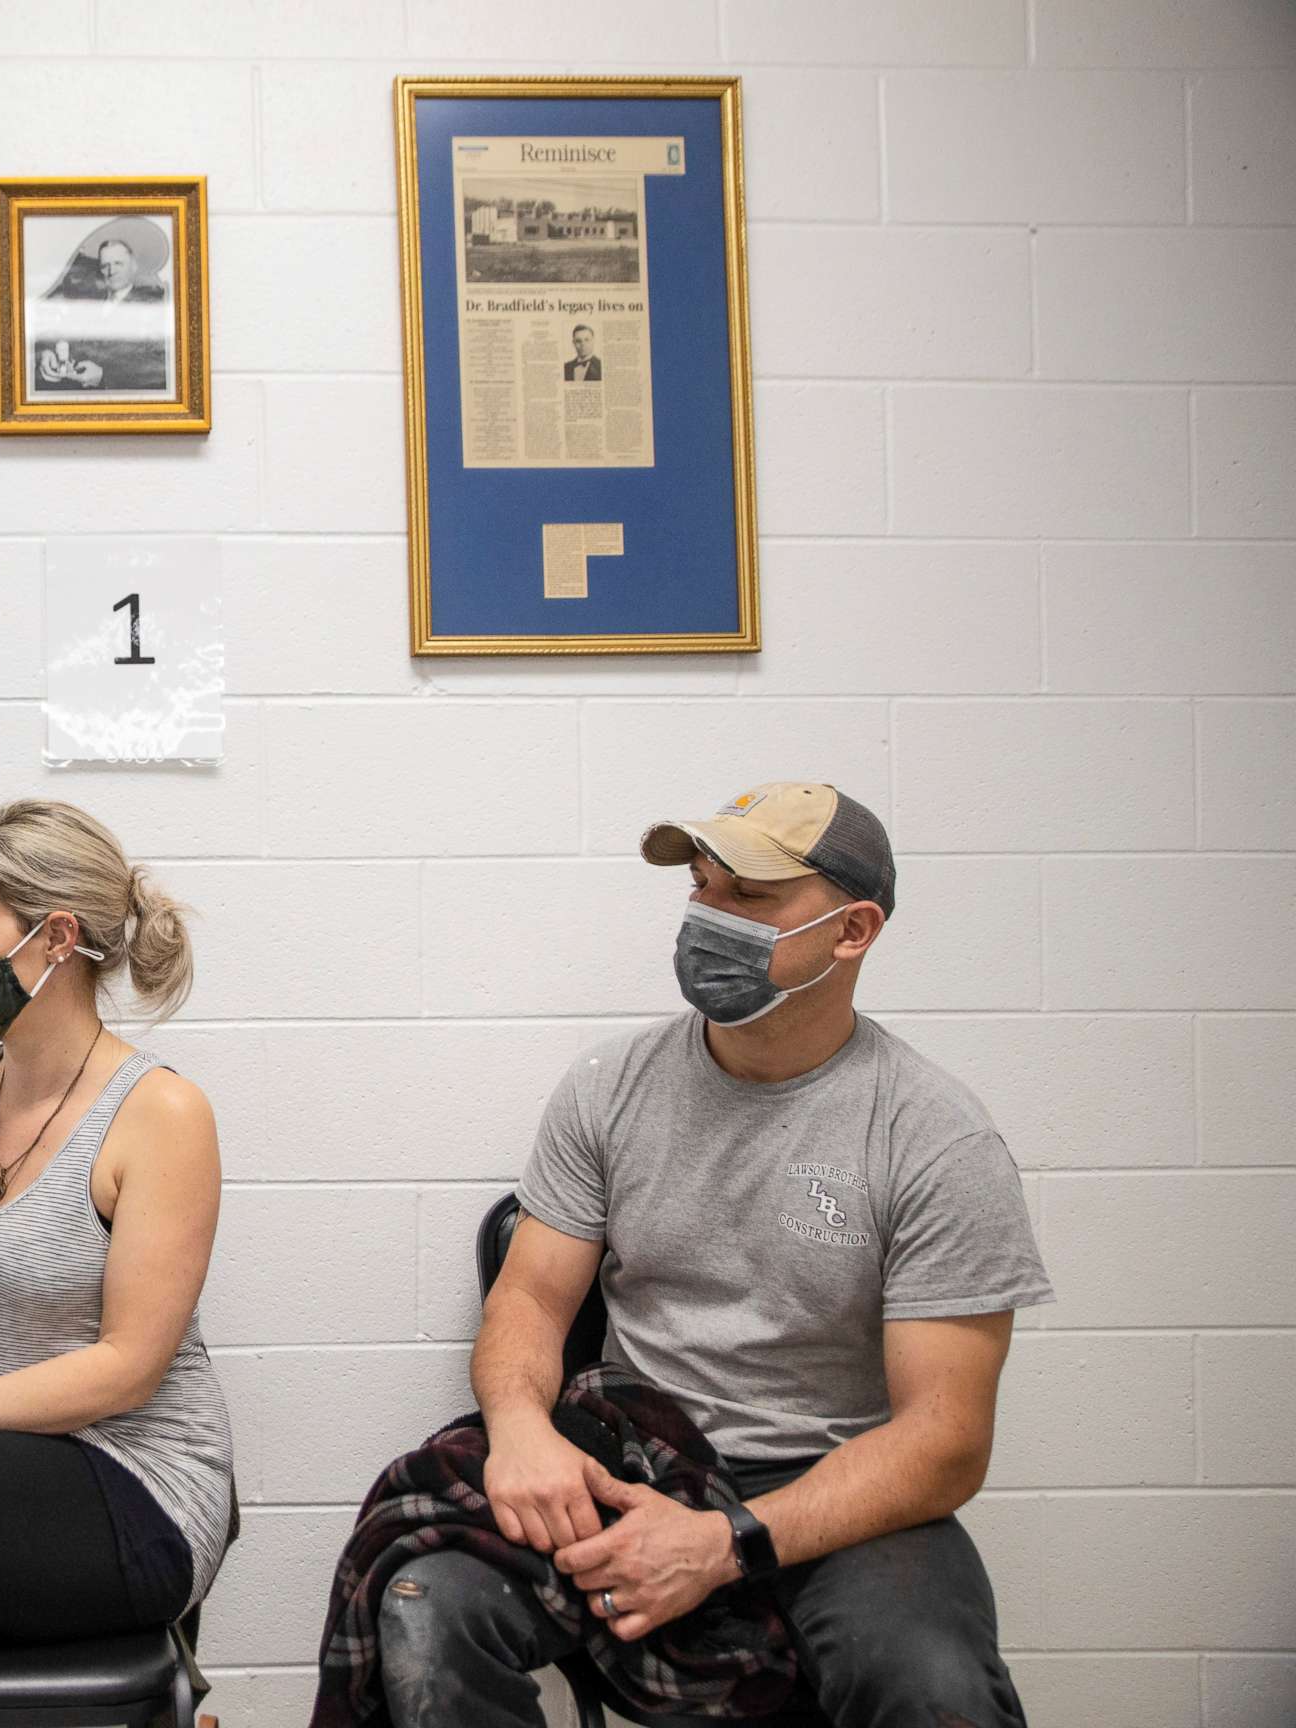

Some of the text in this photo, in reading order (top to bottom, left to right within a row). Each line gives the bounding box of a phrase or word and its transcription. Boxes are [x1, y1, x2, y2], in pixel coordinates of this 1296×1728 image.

[520, 142, 616, 163] Reminisce
[465, 299, 644, 315] Dr. Bradfield's legacy lives on
[113, 593, 155, 665] 1
[787, 1163, 826, 1177] LAWSON
[778, 1212, 869, 1246] CONSTRUCTION
